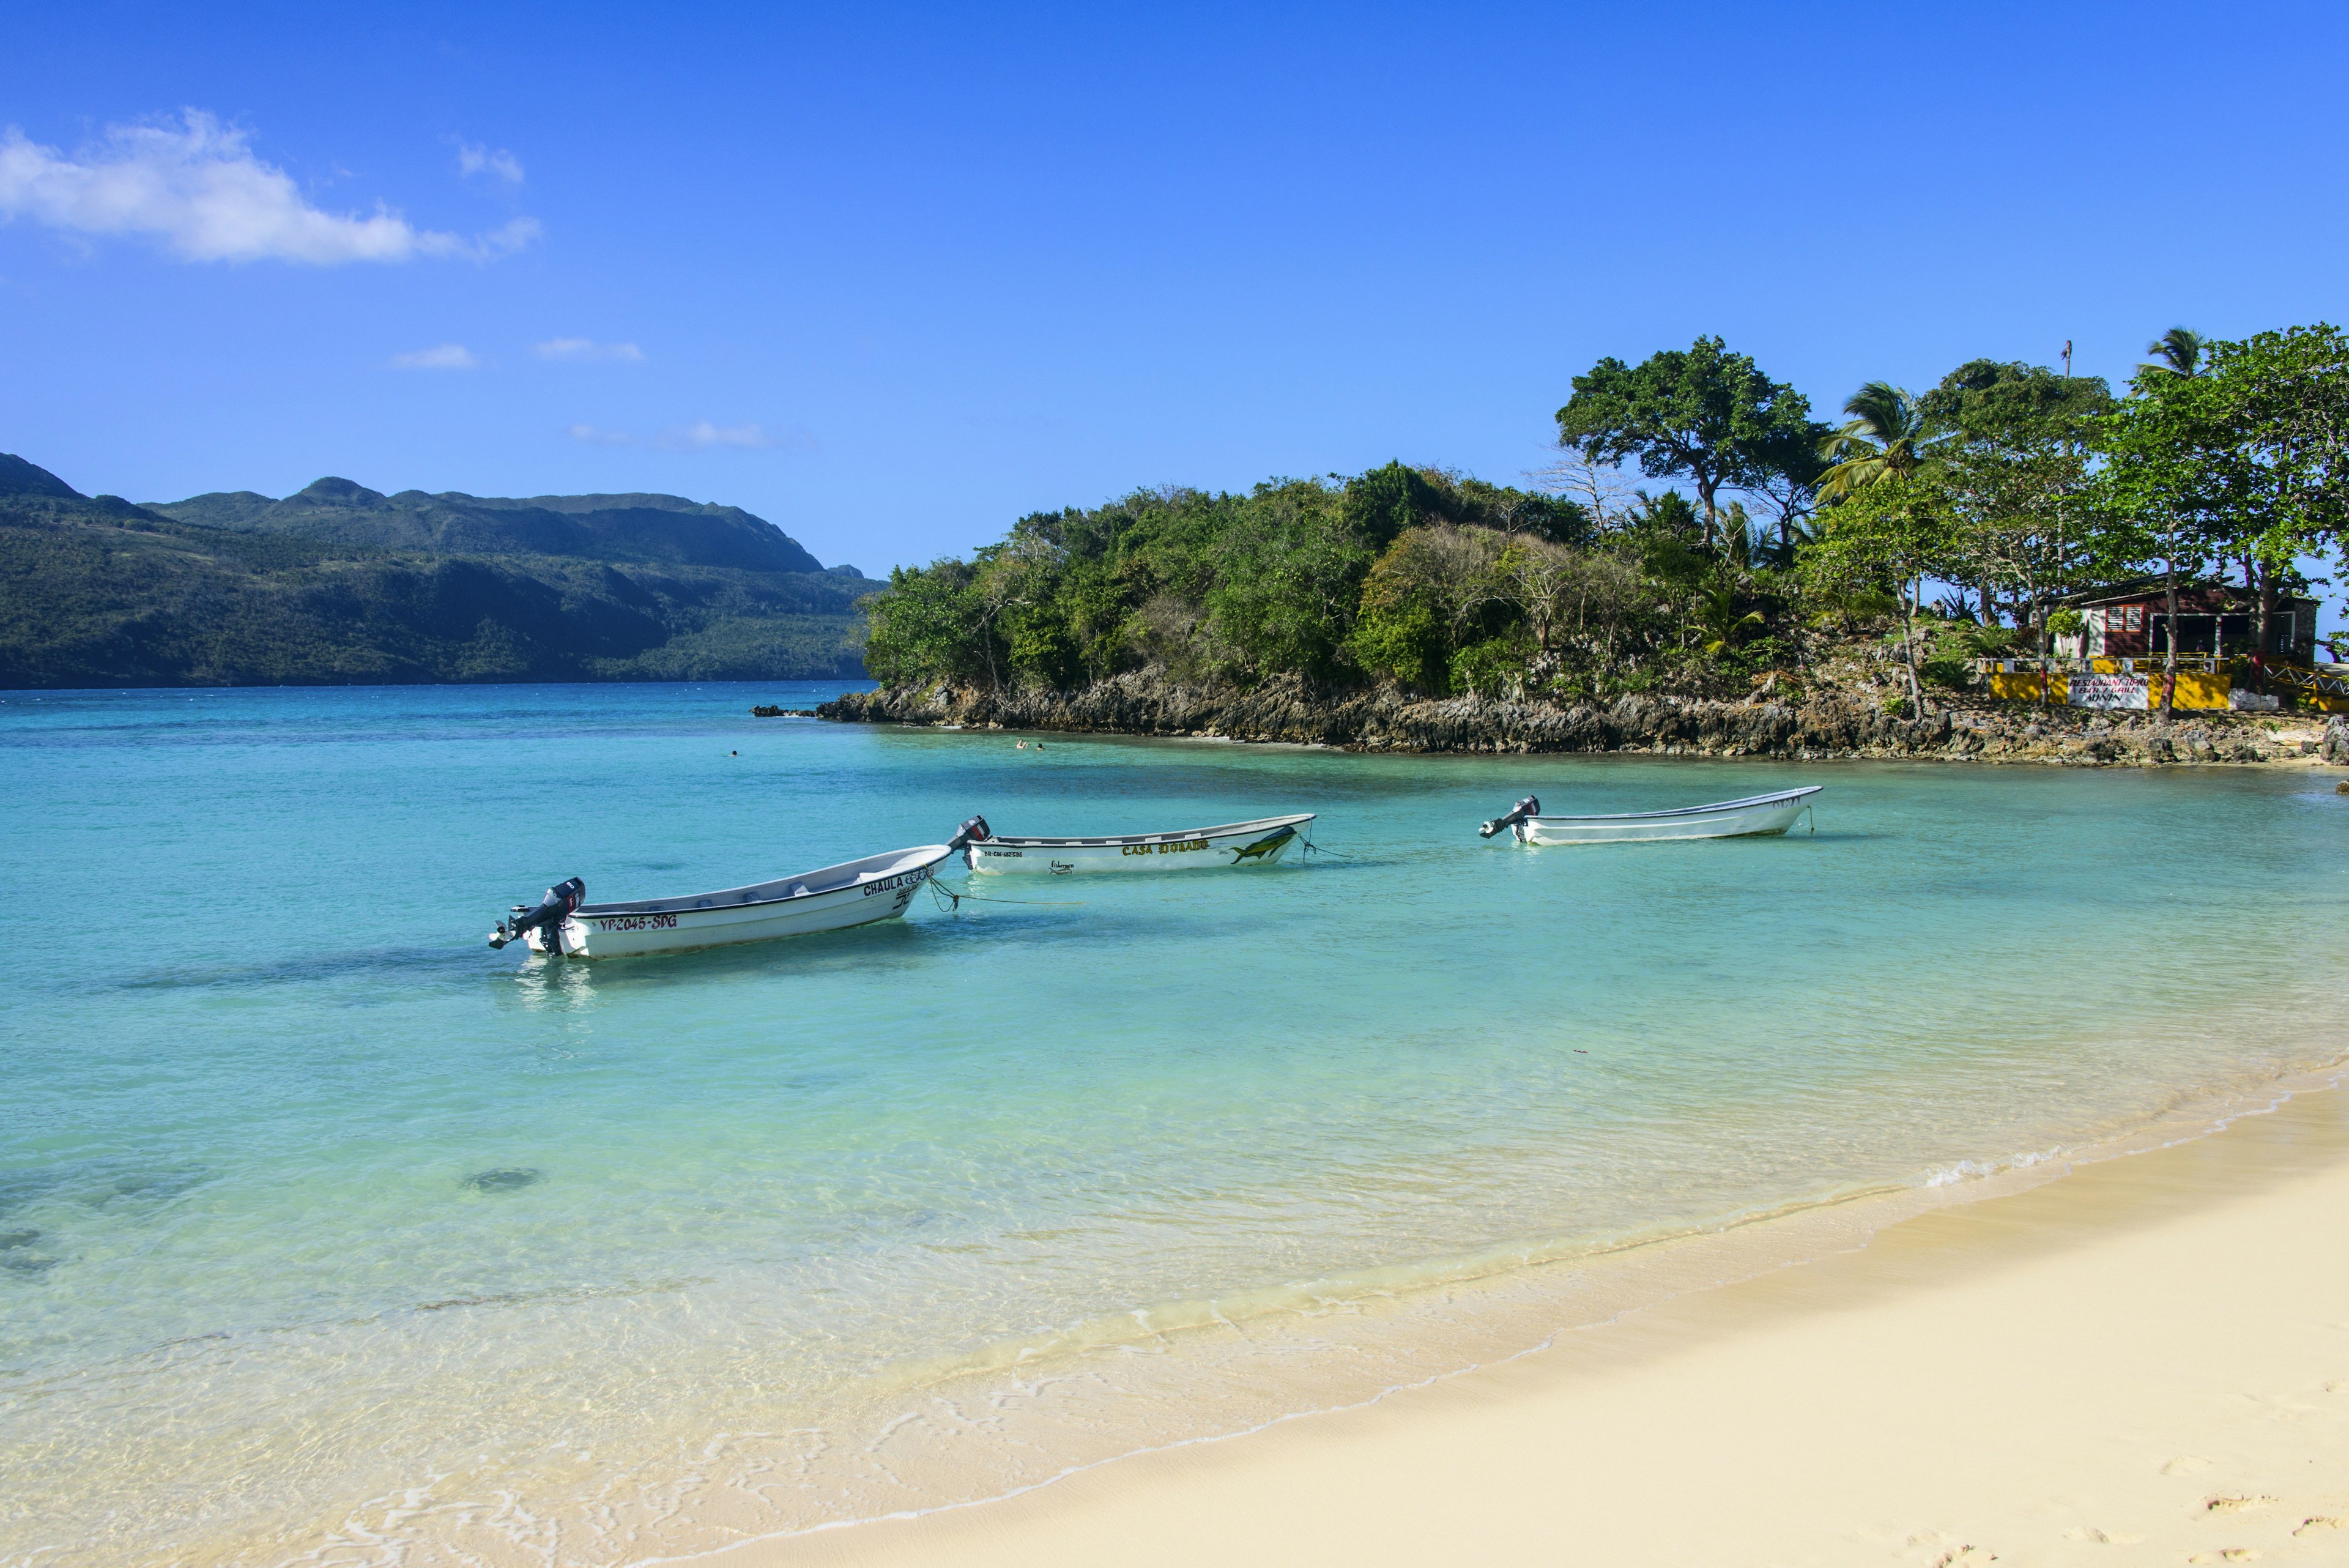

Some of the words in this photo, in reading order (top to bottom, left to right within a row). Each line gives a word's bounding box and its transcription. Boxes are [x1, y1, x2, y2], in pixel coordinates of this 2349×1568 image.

[1123, 844, 1153, 856] CASA
[1158, 839, 1209, 855] DORADO
[864, 877, 904, 896] CHAULA
